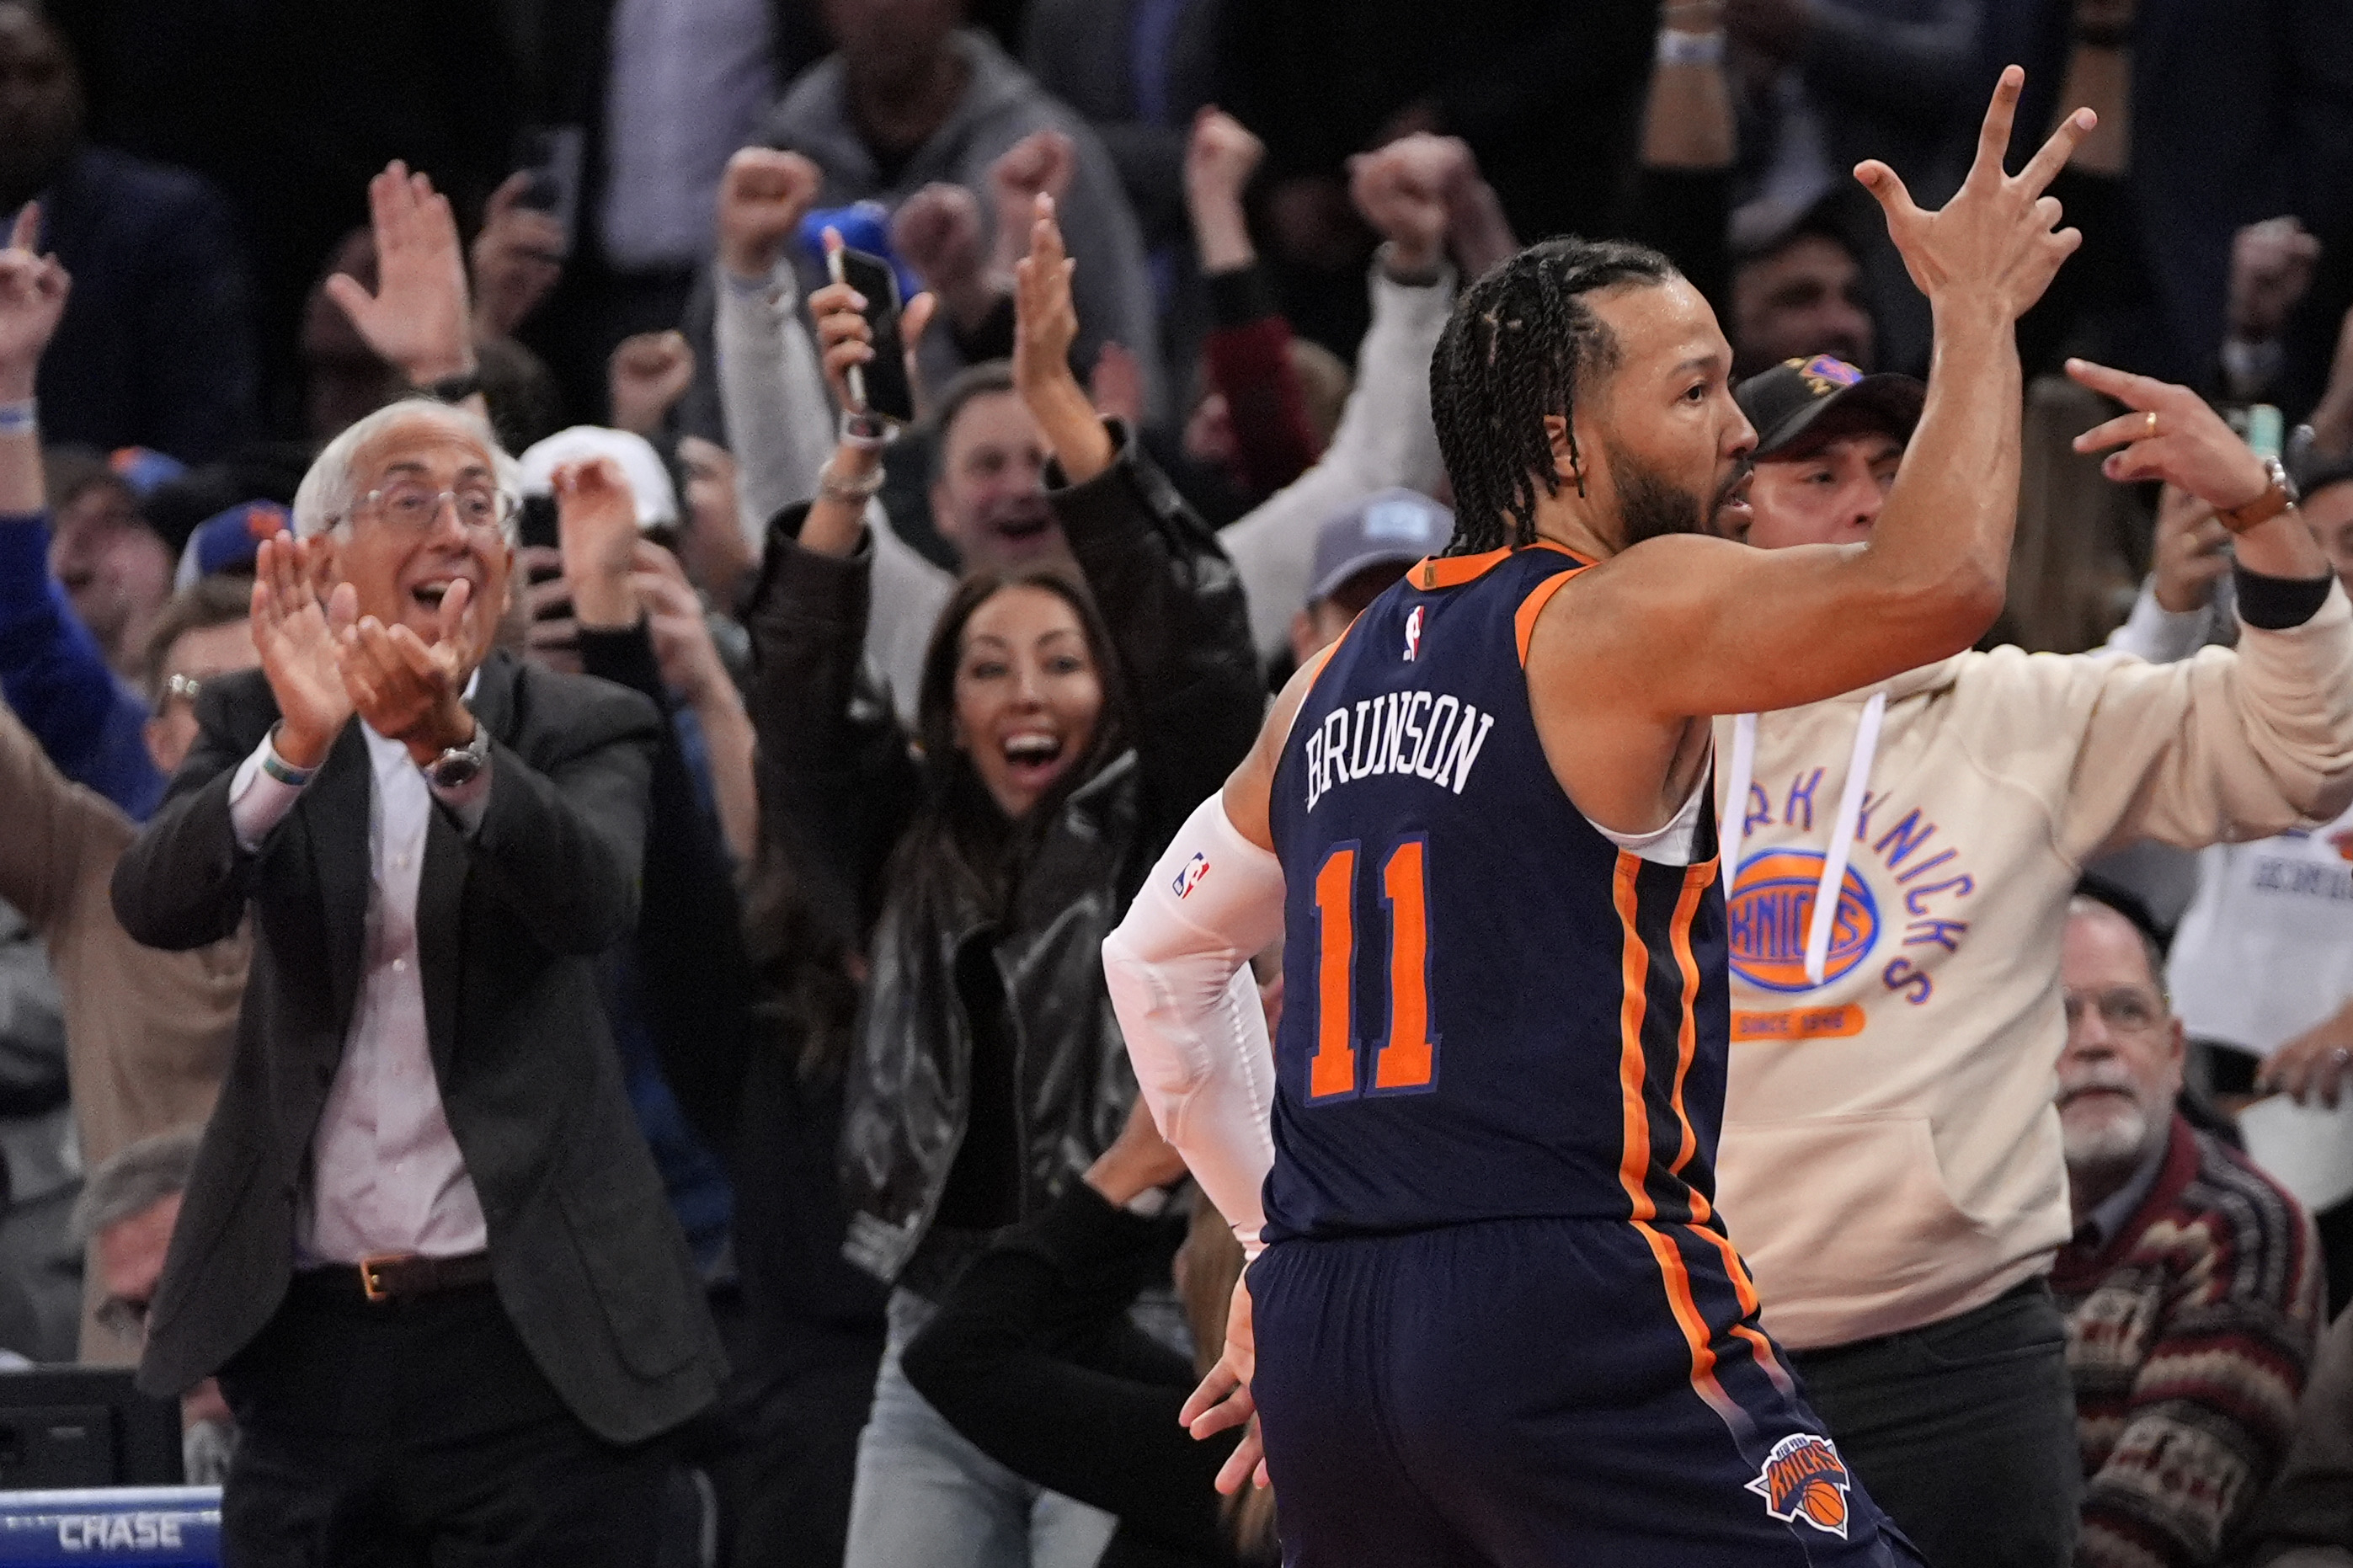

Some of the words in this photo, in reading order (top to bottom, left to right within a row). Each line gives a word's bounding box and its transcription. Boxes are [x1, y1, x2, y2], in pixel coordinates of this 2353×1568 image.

[1305, 691, 1494, 813] BRUNSON
[1731, 891, 1859, 957] KNICS
[1306, 831, 1441, 1107] 11
[1767, 1440, 1846, 1512] KNICKS
[1775, 1442, 1791, 1460] NEW
[1788, 1436, 1810, 1449] YORK
[57, 1513, 184, 1550] CHASE
